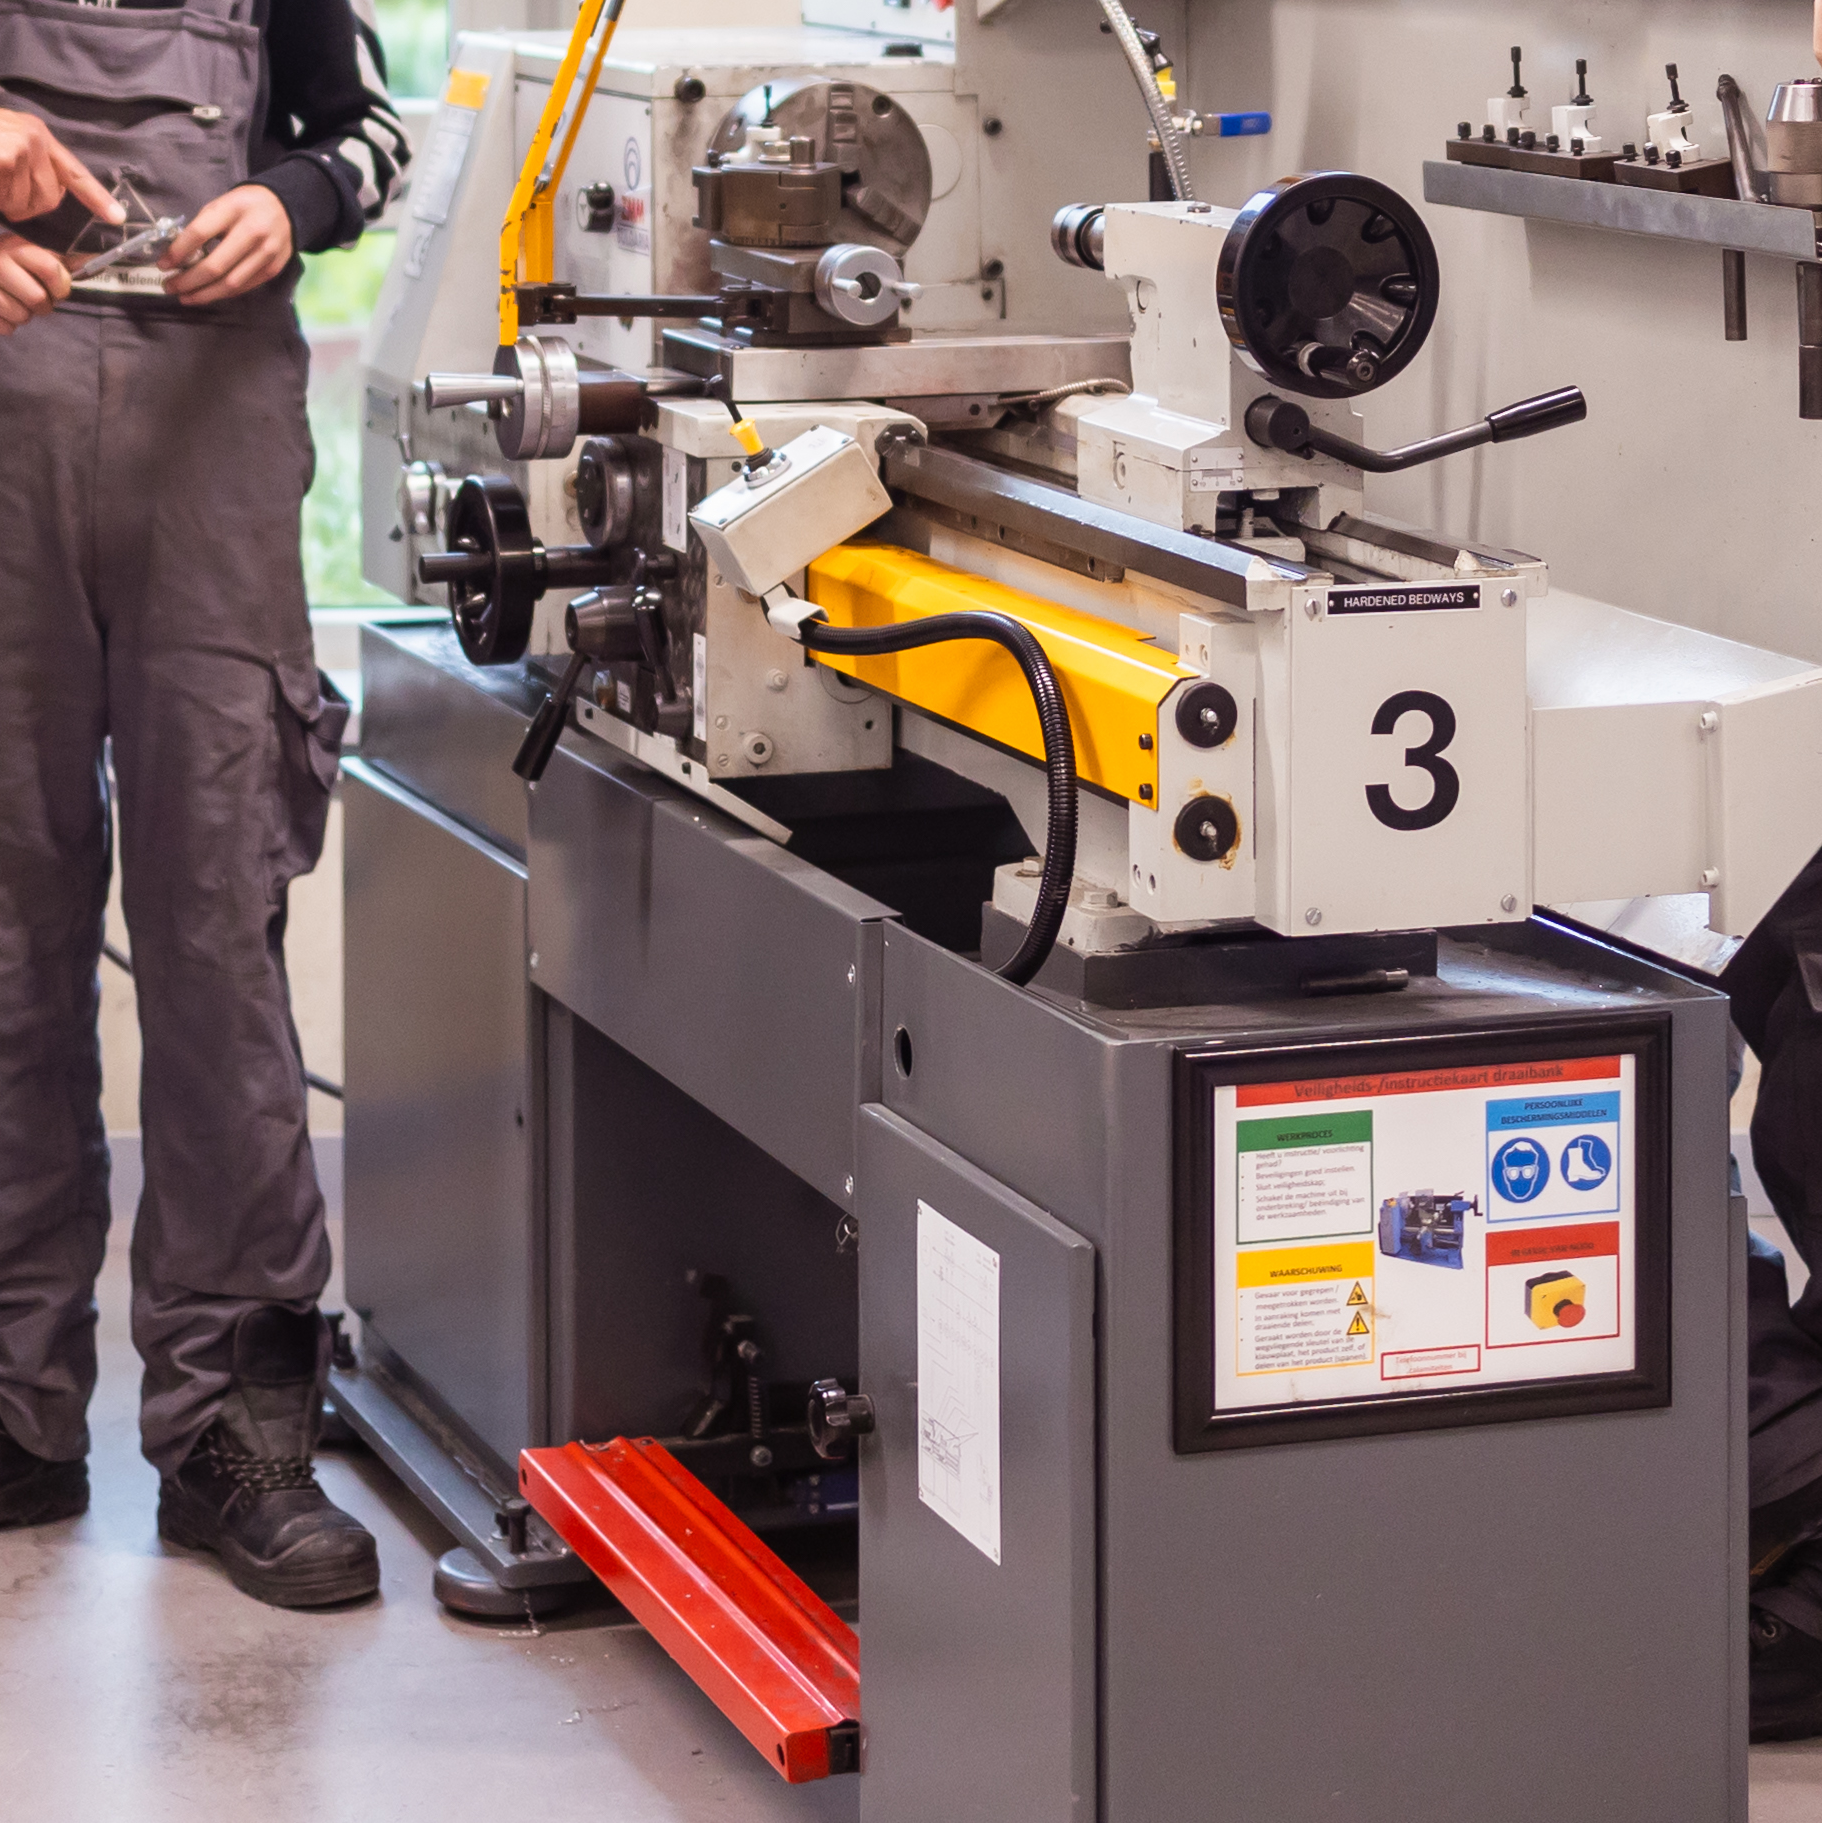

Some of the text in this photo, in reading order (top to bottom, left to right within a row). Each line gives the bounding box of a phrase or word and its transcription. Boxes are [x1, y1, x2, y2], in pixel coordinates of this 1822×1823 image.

[118, 274, 162, 287] Molend
[1344, 592, 1465, 608] HARDENED BEDWAYS
[1365, 690, 1460, 831] 3
[1493, 1065, 1563, 1082] draaibank
[1277, 1130, 1333, 1142] WERKPROCES
[1295, 1190, 1326, 1199] machine
[1270, 1265, 1342, 1277] WAARSCHUWING
[1300, 1287, 1334, 1297] gegrepen
[1264, 1312, 1298, 1321] aanraking
[1286, 1331, 1312, 1339] worden
[1314, 1329, 1331, 1337] door
[1311, 1346, 1339, 1356] product
[1305, 1356, 1333, 1366] product
